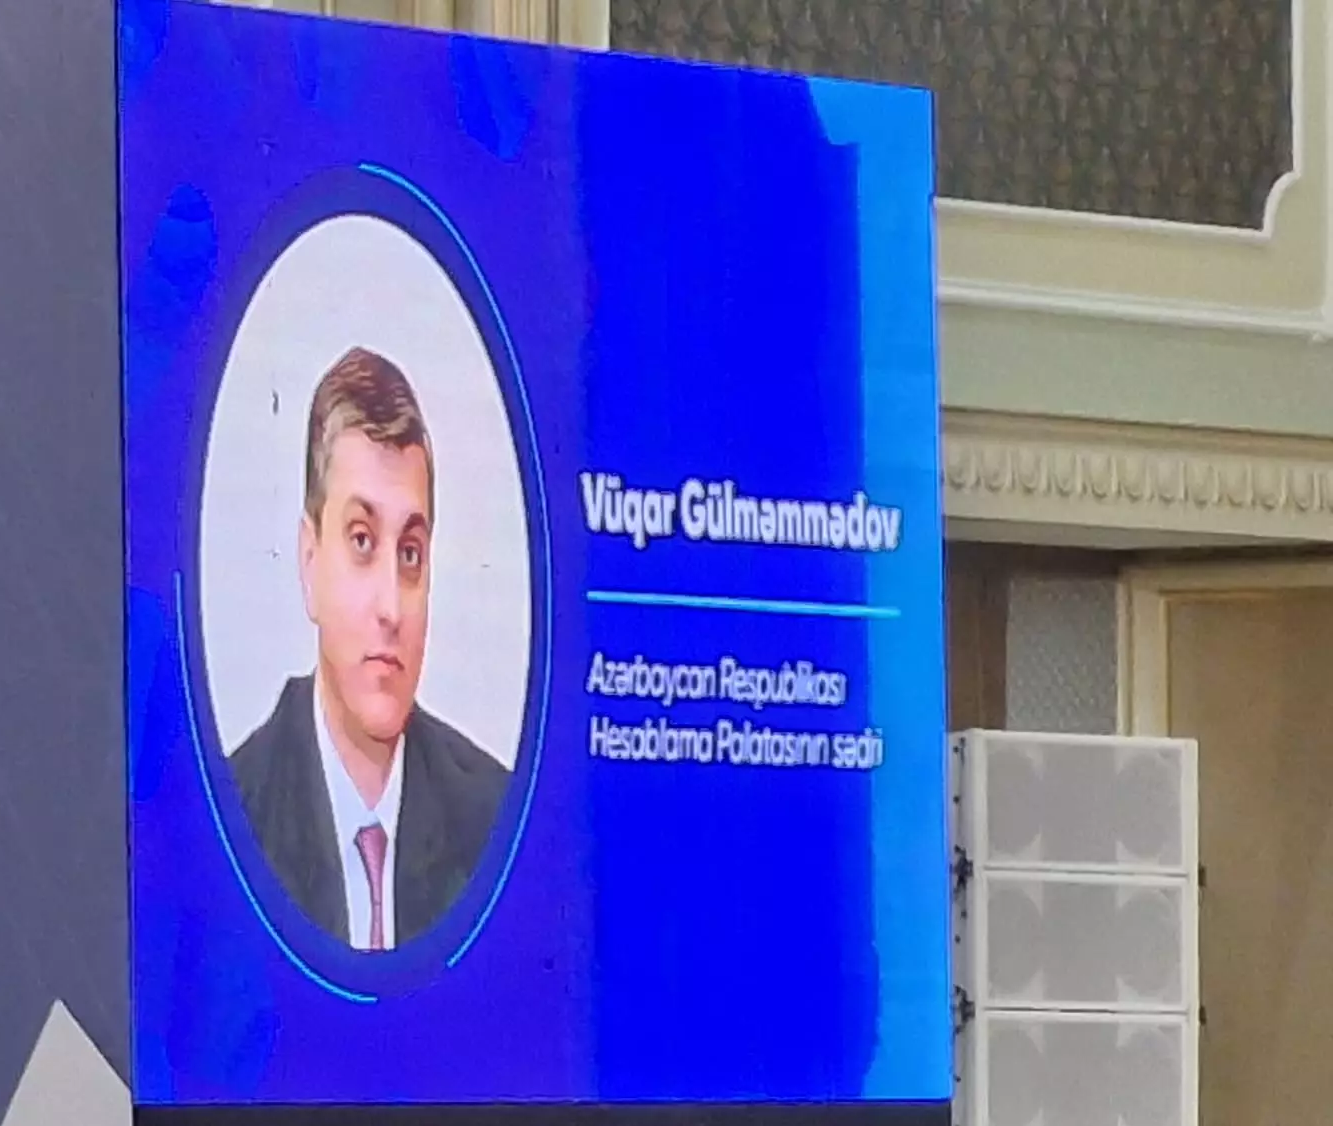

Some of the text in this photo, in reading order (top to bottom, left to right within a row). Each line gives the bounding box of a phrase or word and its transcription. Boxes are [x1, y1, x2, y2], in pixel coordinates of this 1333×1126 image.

[579, 472, 901, 552] Vüqar Gülməmmədov
[586, 651, 716, 706] Azərbaycan
[589, 716, 713, 763] Hesablama
